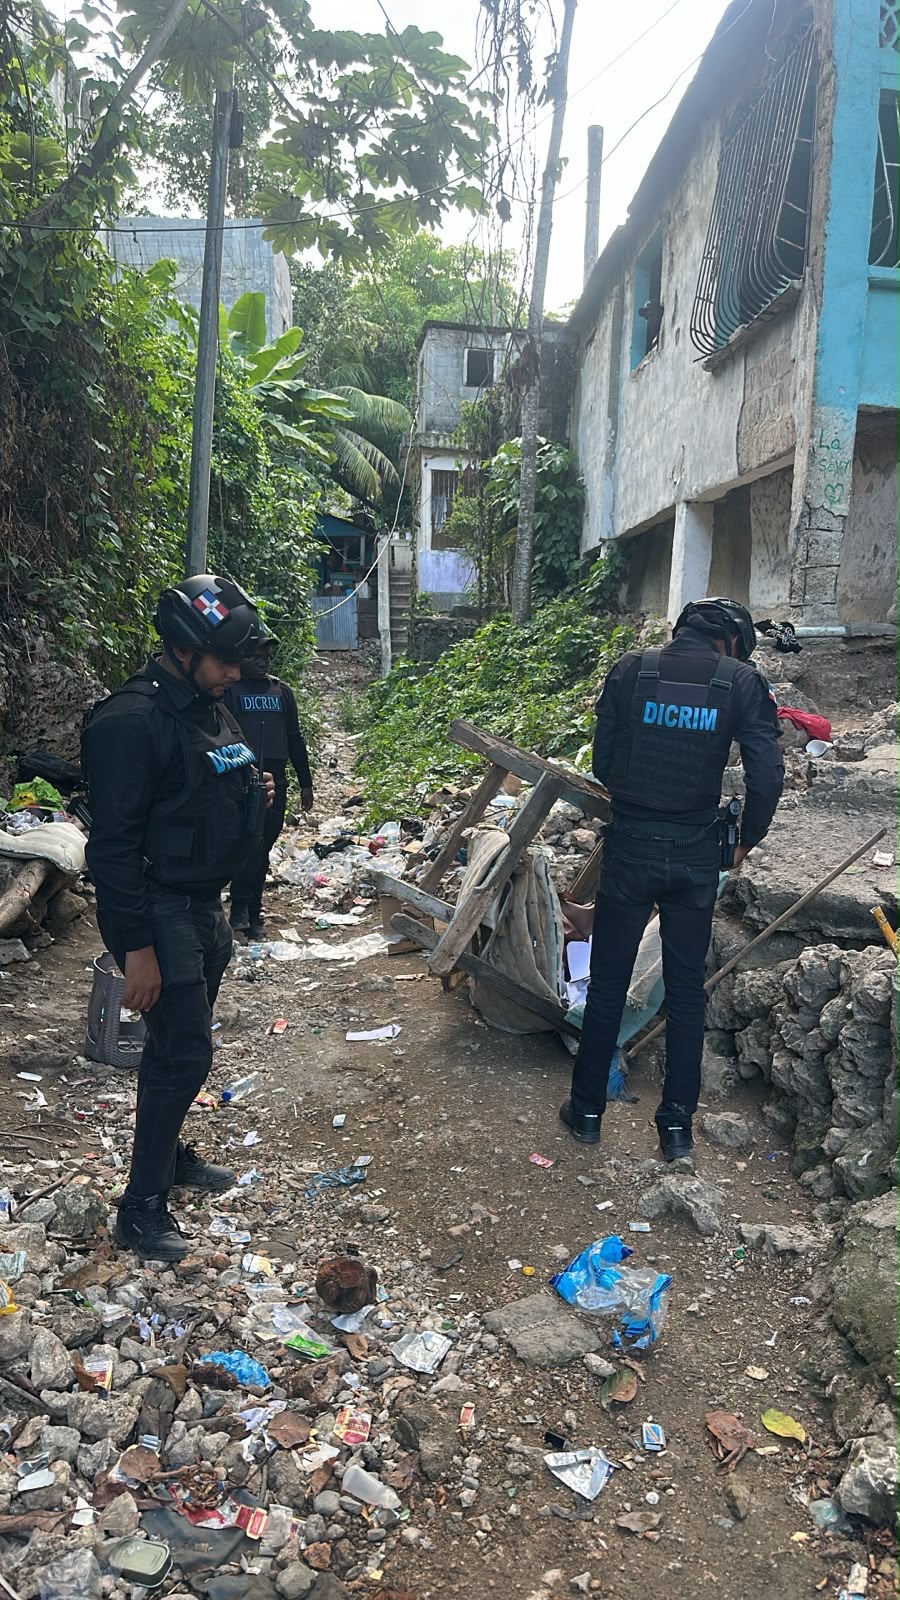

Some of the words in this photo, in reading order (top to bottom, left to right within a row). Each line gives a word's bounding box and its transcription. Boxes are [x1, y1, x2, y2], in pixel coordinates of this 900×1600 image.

[819, 428, 843, 450] La
[244, 696, 280, 710] DICRIM
[643, 701, 718, 731] DICRIM
